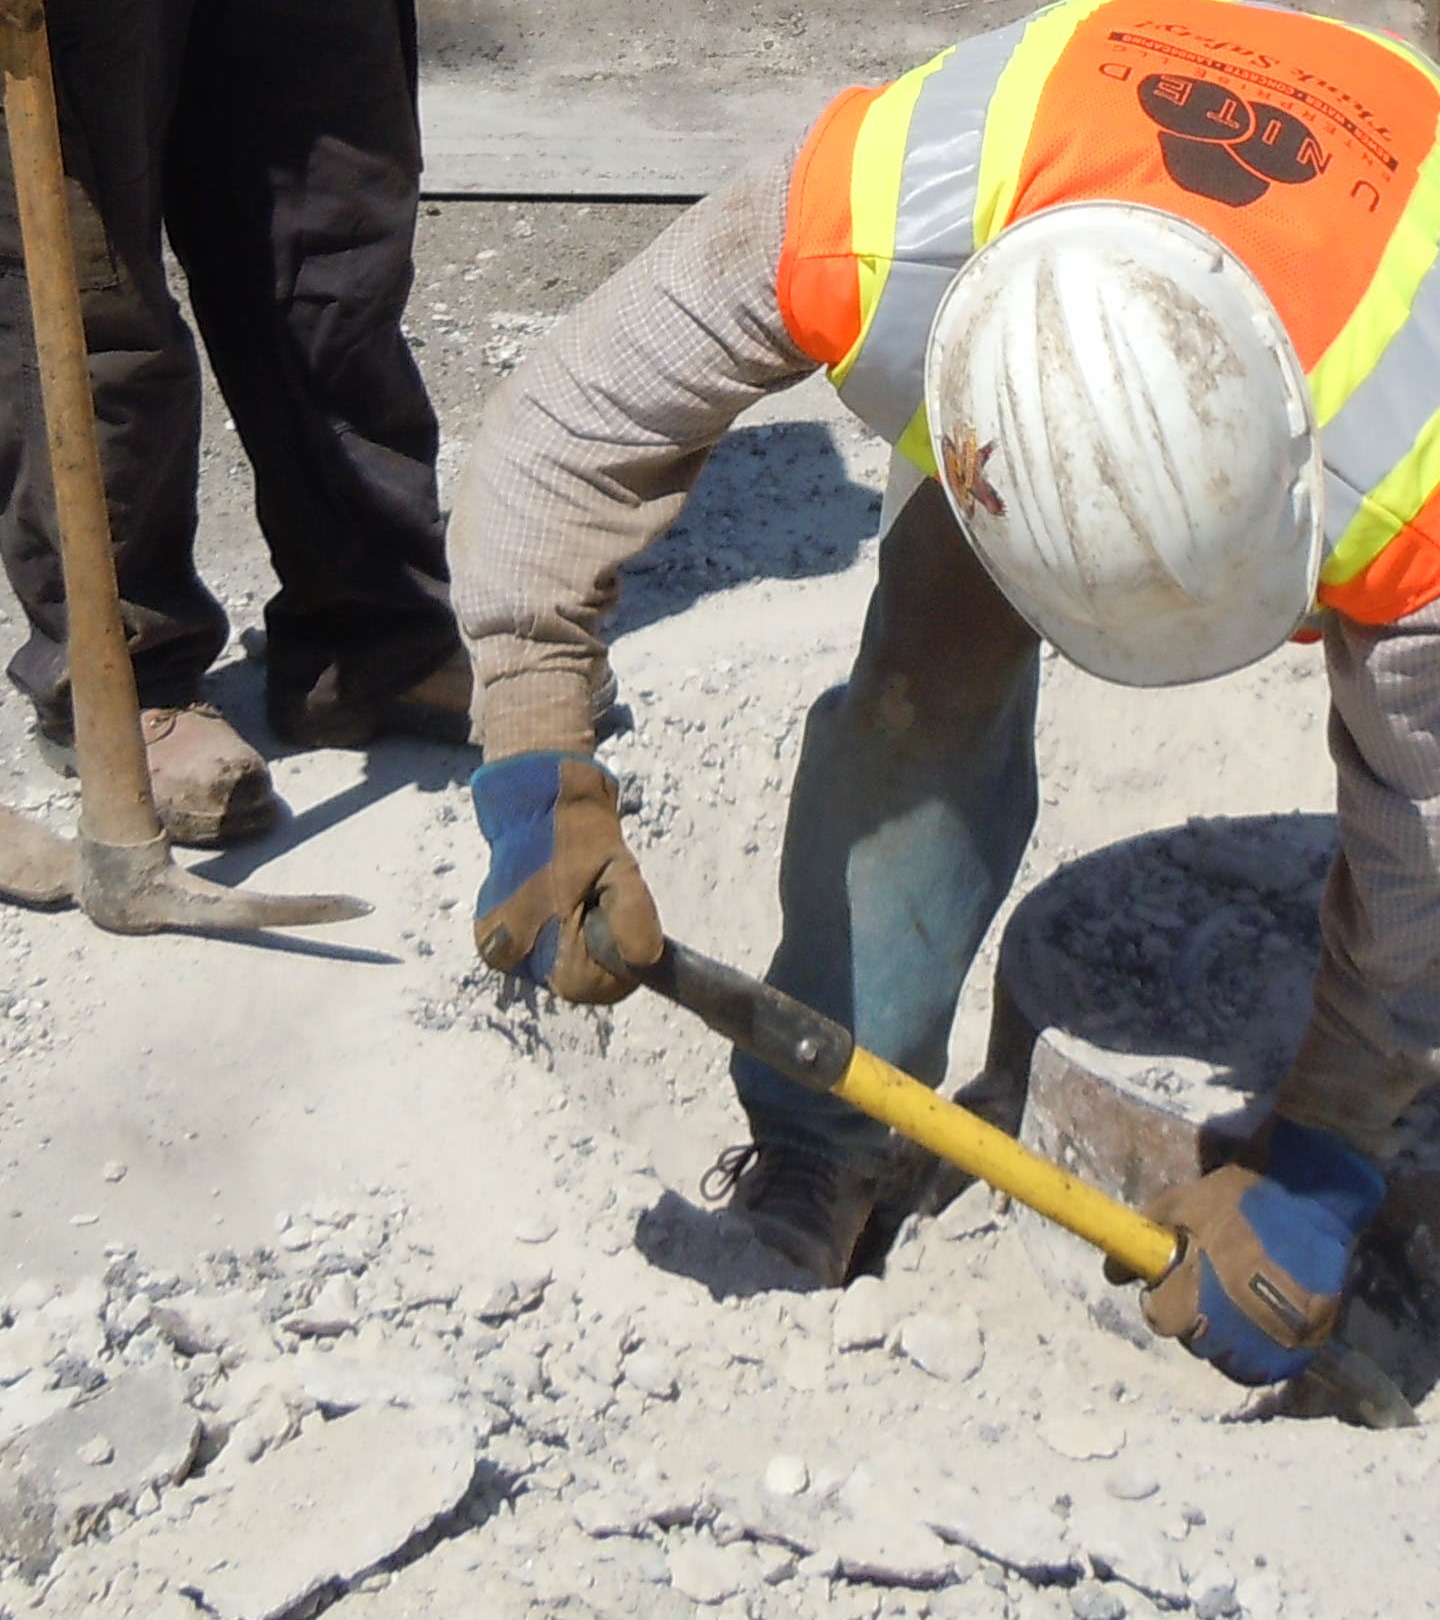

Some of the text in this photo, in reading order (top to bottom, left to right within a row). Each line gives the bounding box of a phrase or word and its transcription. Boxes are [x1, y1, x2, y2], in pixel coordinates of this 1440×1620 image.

[1098, 62, 1381, 213] UNITED
[1120, 32, 1392, 165] SEWER WATER CONCRETE LANDSCAPING
[1289, 67, 1392, 143] Think
